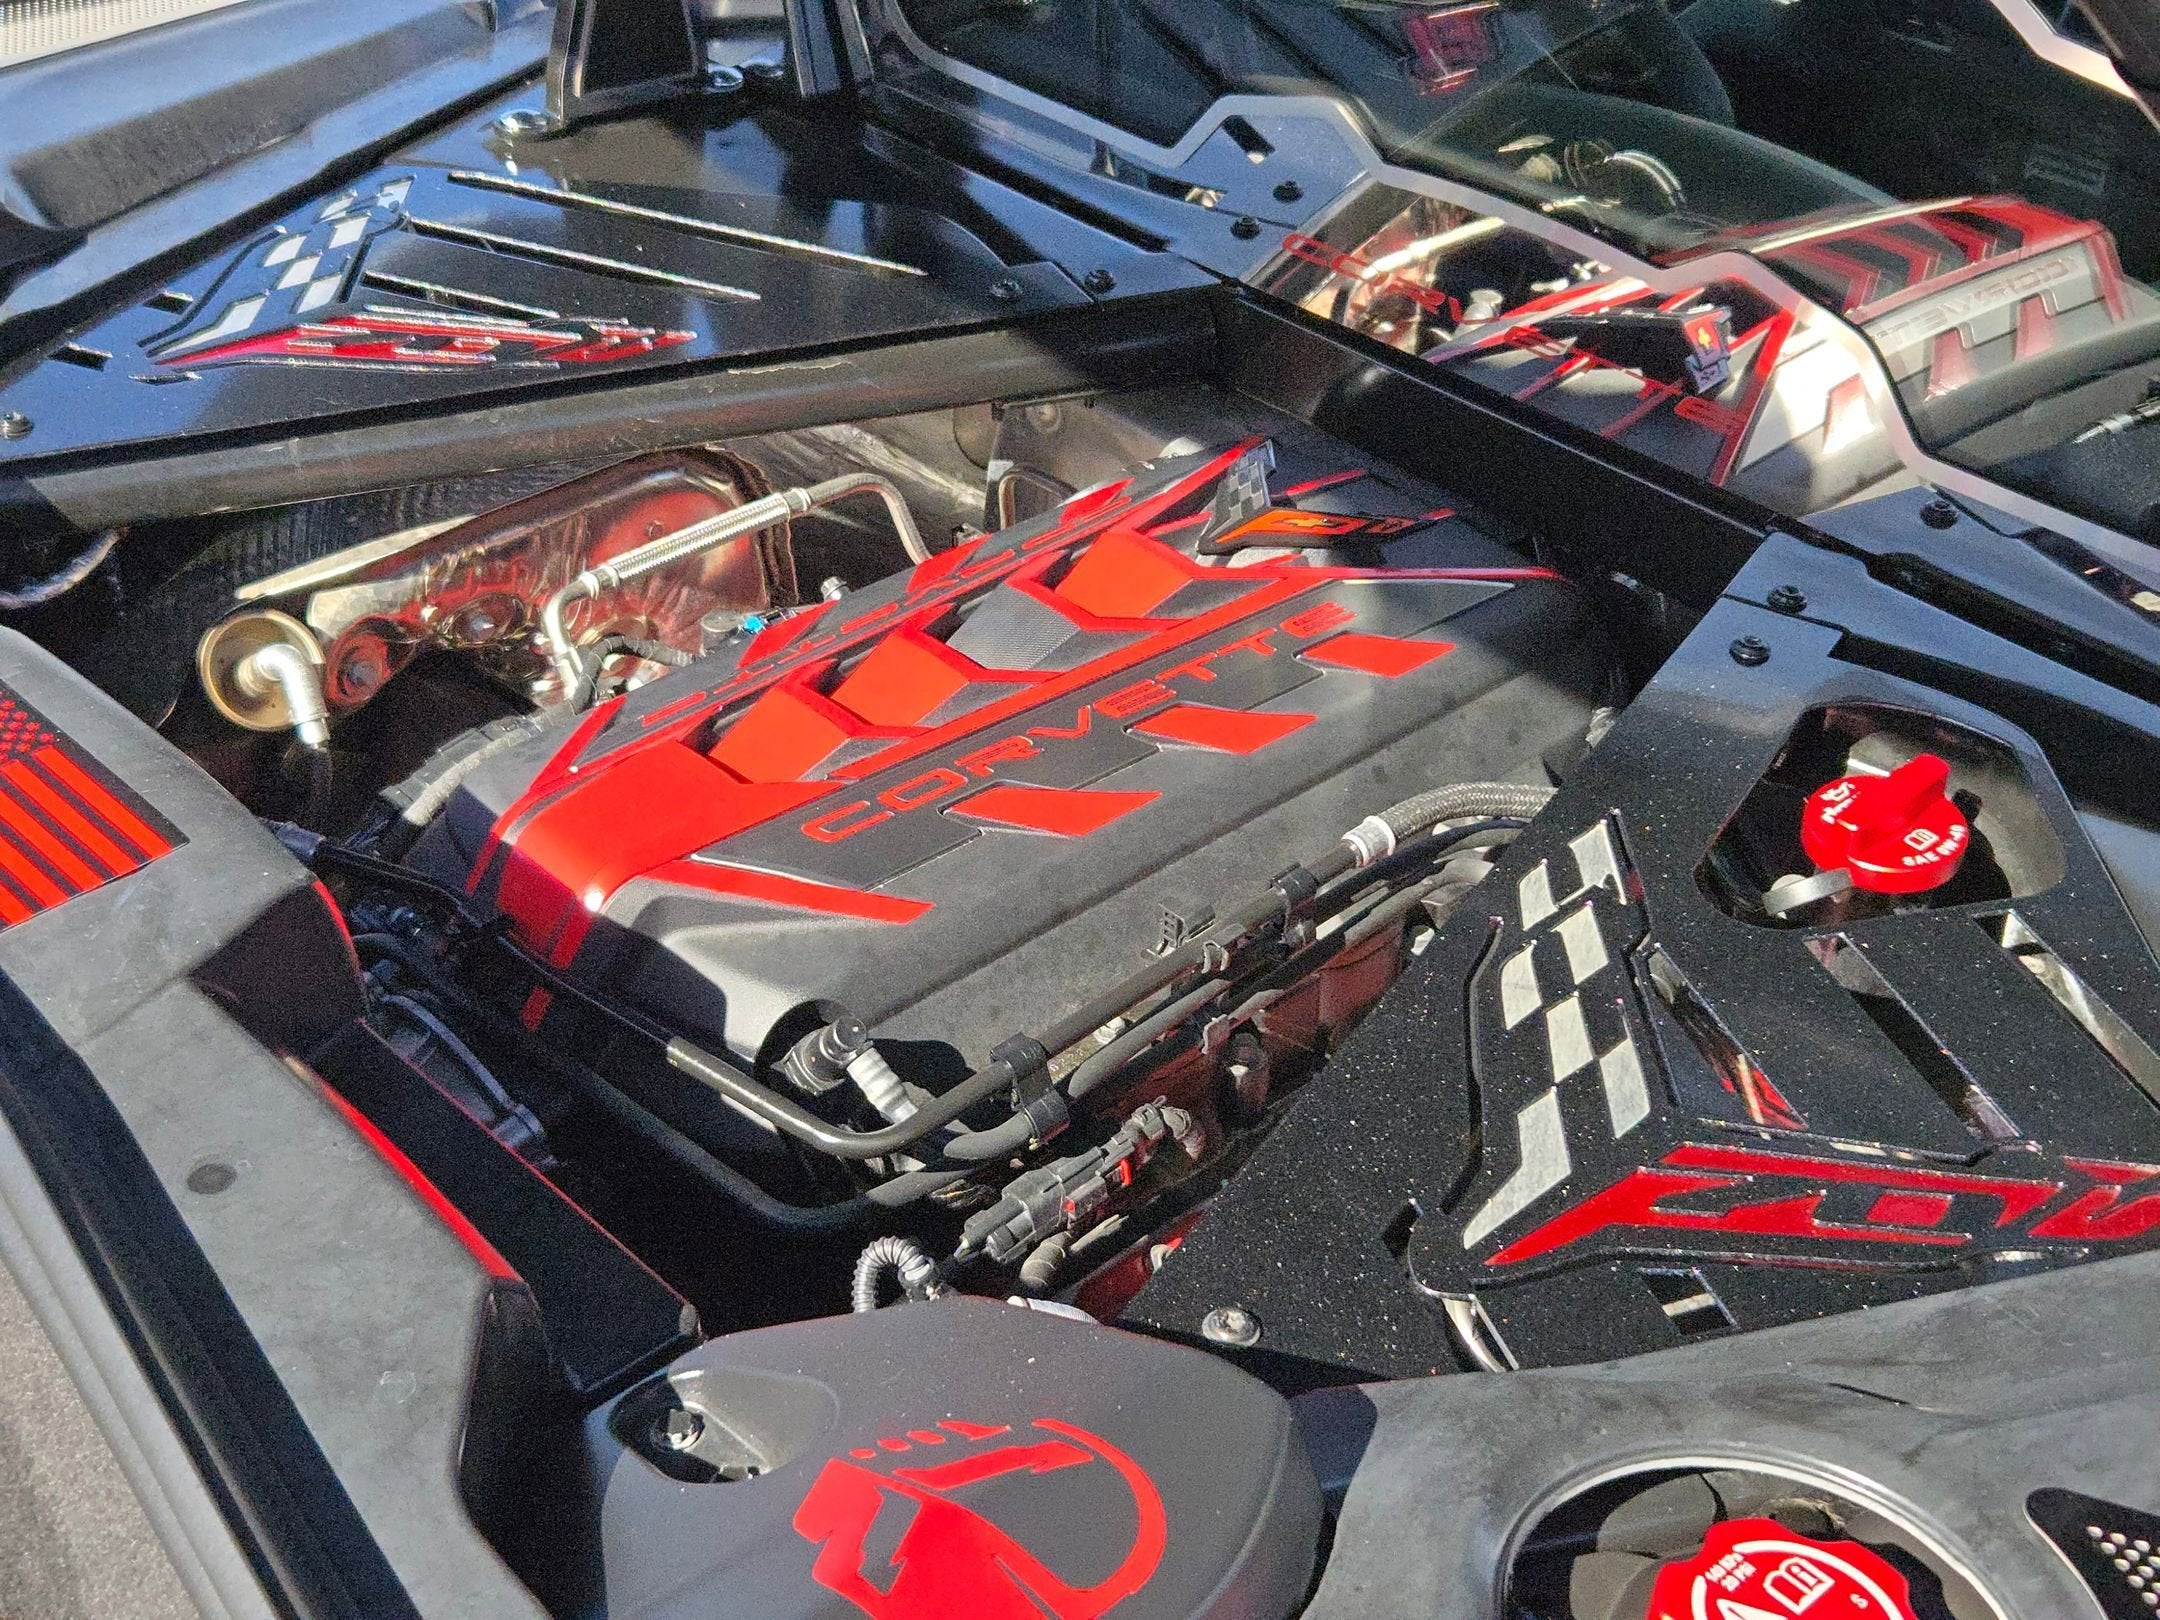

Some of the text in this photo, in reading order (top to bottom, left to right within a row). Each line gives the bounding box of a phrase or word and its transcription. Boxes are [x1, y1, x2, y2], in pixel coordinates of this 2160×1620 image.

[801, 601, 1357, 842] CORVETTE
[1902, 851, 1940, 867] SAE
[1720, 1574, 1741, 1593] 20
